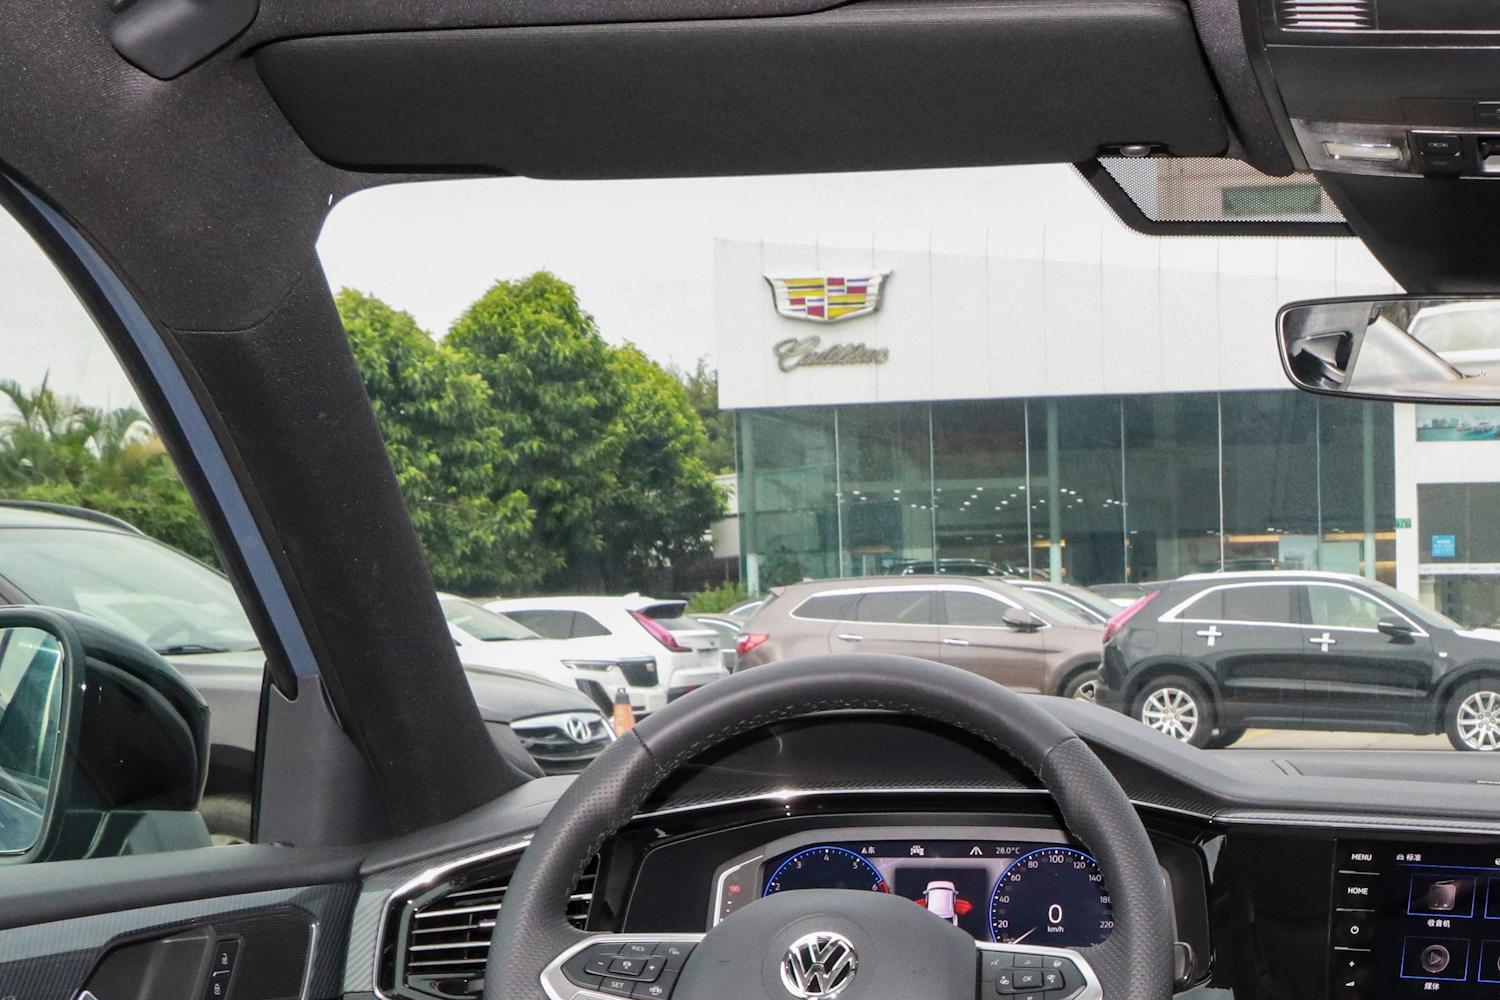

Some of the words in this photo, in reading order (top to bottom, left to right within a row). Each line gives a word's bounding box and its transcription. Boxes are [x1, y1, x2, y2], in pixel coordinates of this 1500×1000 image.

[1048, 855, 1064, 864] 100
[1351, 853, 1373, 862] MENU
[796, 860, 802, 869] 3
[852, 862, 859, 870] 5
[1028, 861, 1039, 869] 80
[1073, 861, 1086, 869] 120
[1010, 874, 1021, 882] 60
[1088, 874, 1102, 882] 140
[775, 882, 781, 891] 2
[1347, 886, 1369, 896] HOME
[999, 895, 1010, 904] 40
[1048, 904, 1063, 924] 0
[997, 920, 1009, 928] 20
[1100, 920, 1114, 929] 220
[1427, 919, 1451, 928] 收音机
[1047, 925, 1065, 933] km/h
[611, 981, 625, 989] SET
